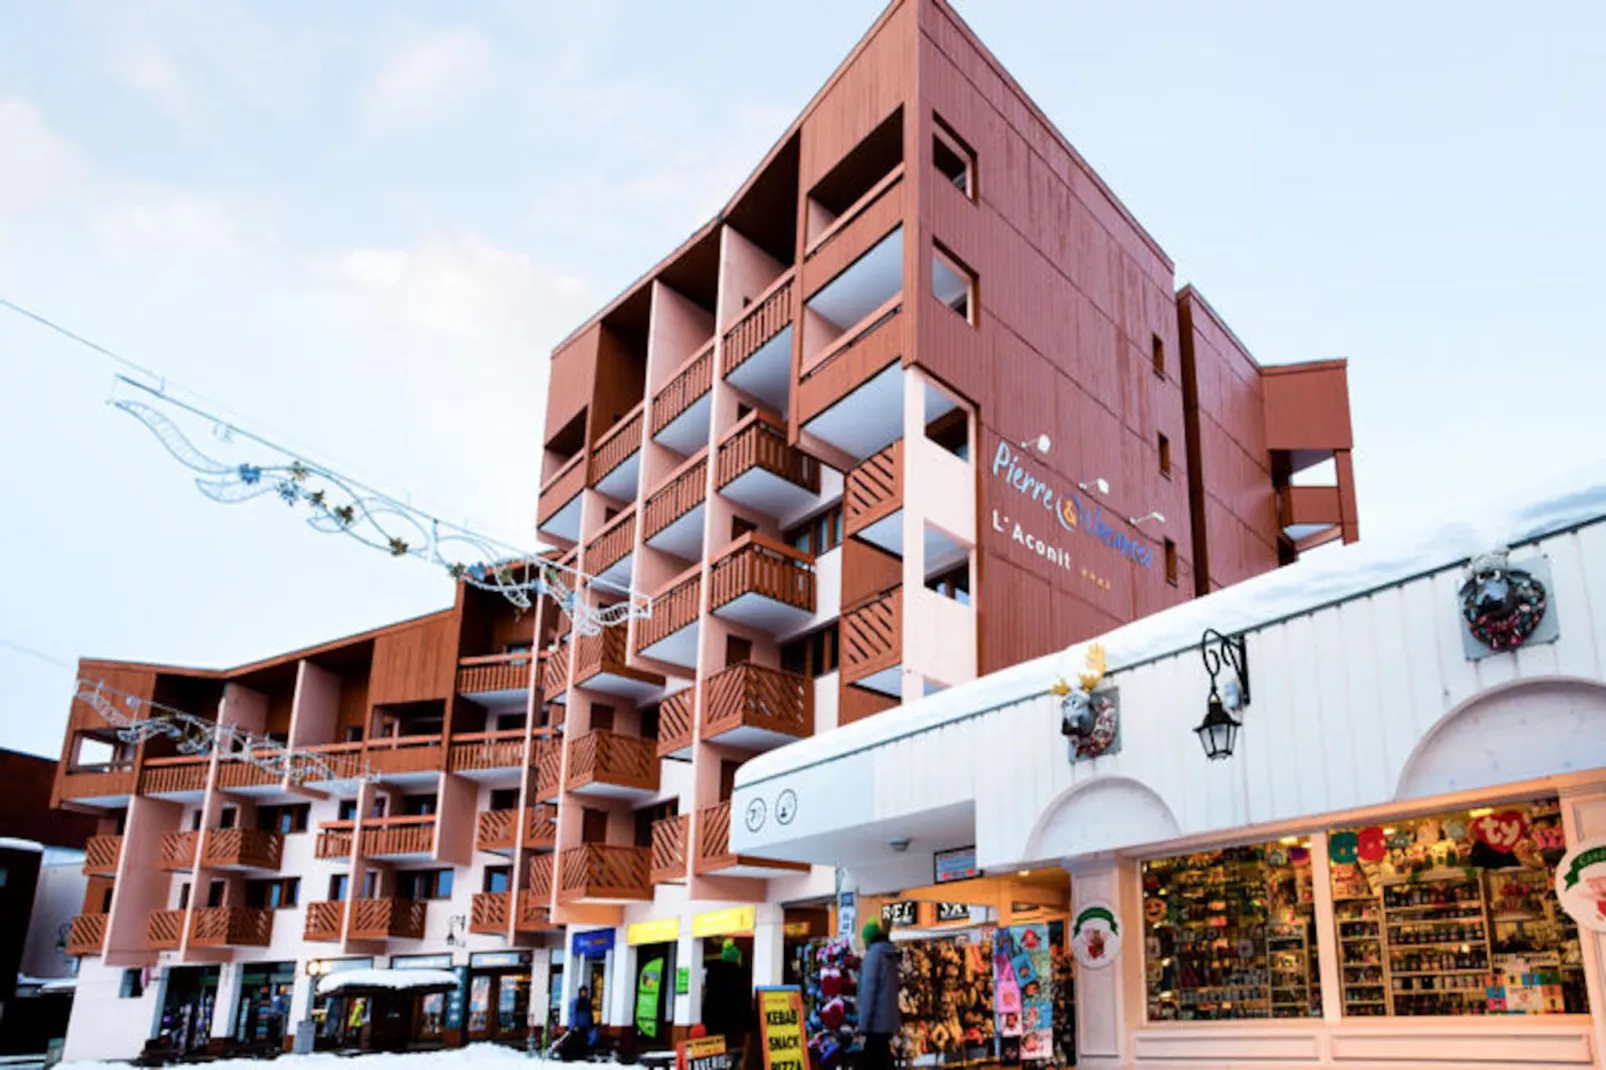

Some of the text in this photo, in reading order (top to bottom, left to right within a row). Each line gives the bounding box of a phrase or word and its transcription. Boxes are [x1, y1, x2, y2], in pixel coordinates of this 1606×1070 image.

[992, 440, 1053, 511] Pierre
[1479, 817, 1520, 847] ty
[766, 1010, 798, 1025] KEBAB
[768, 1035, 800, 1052] SNACK
